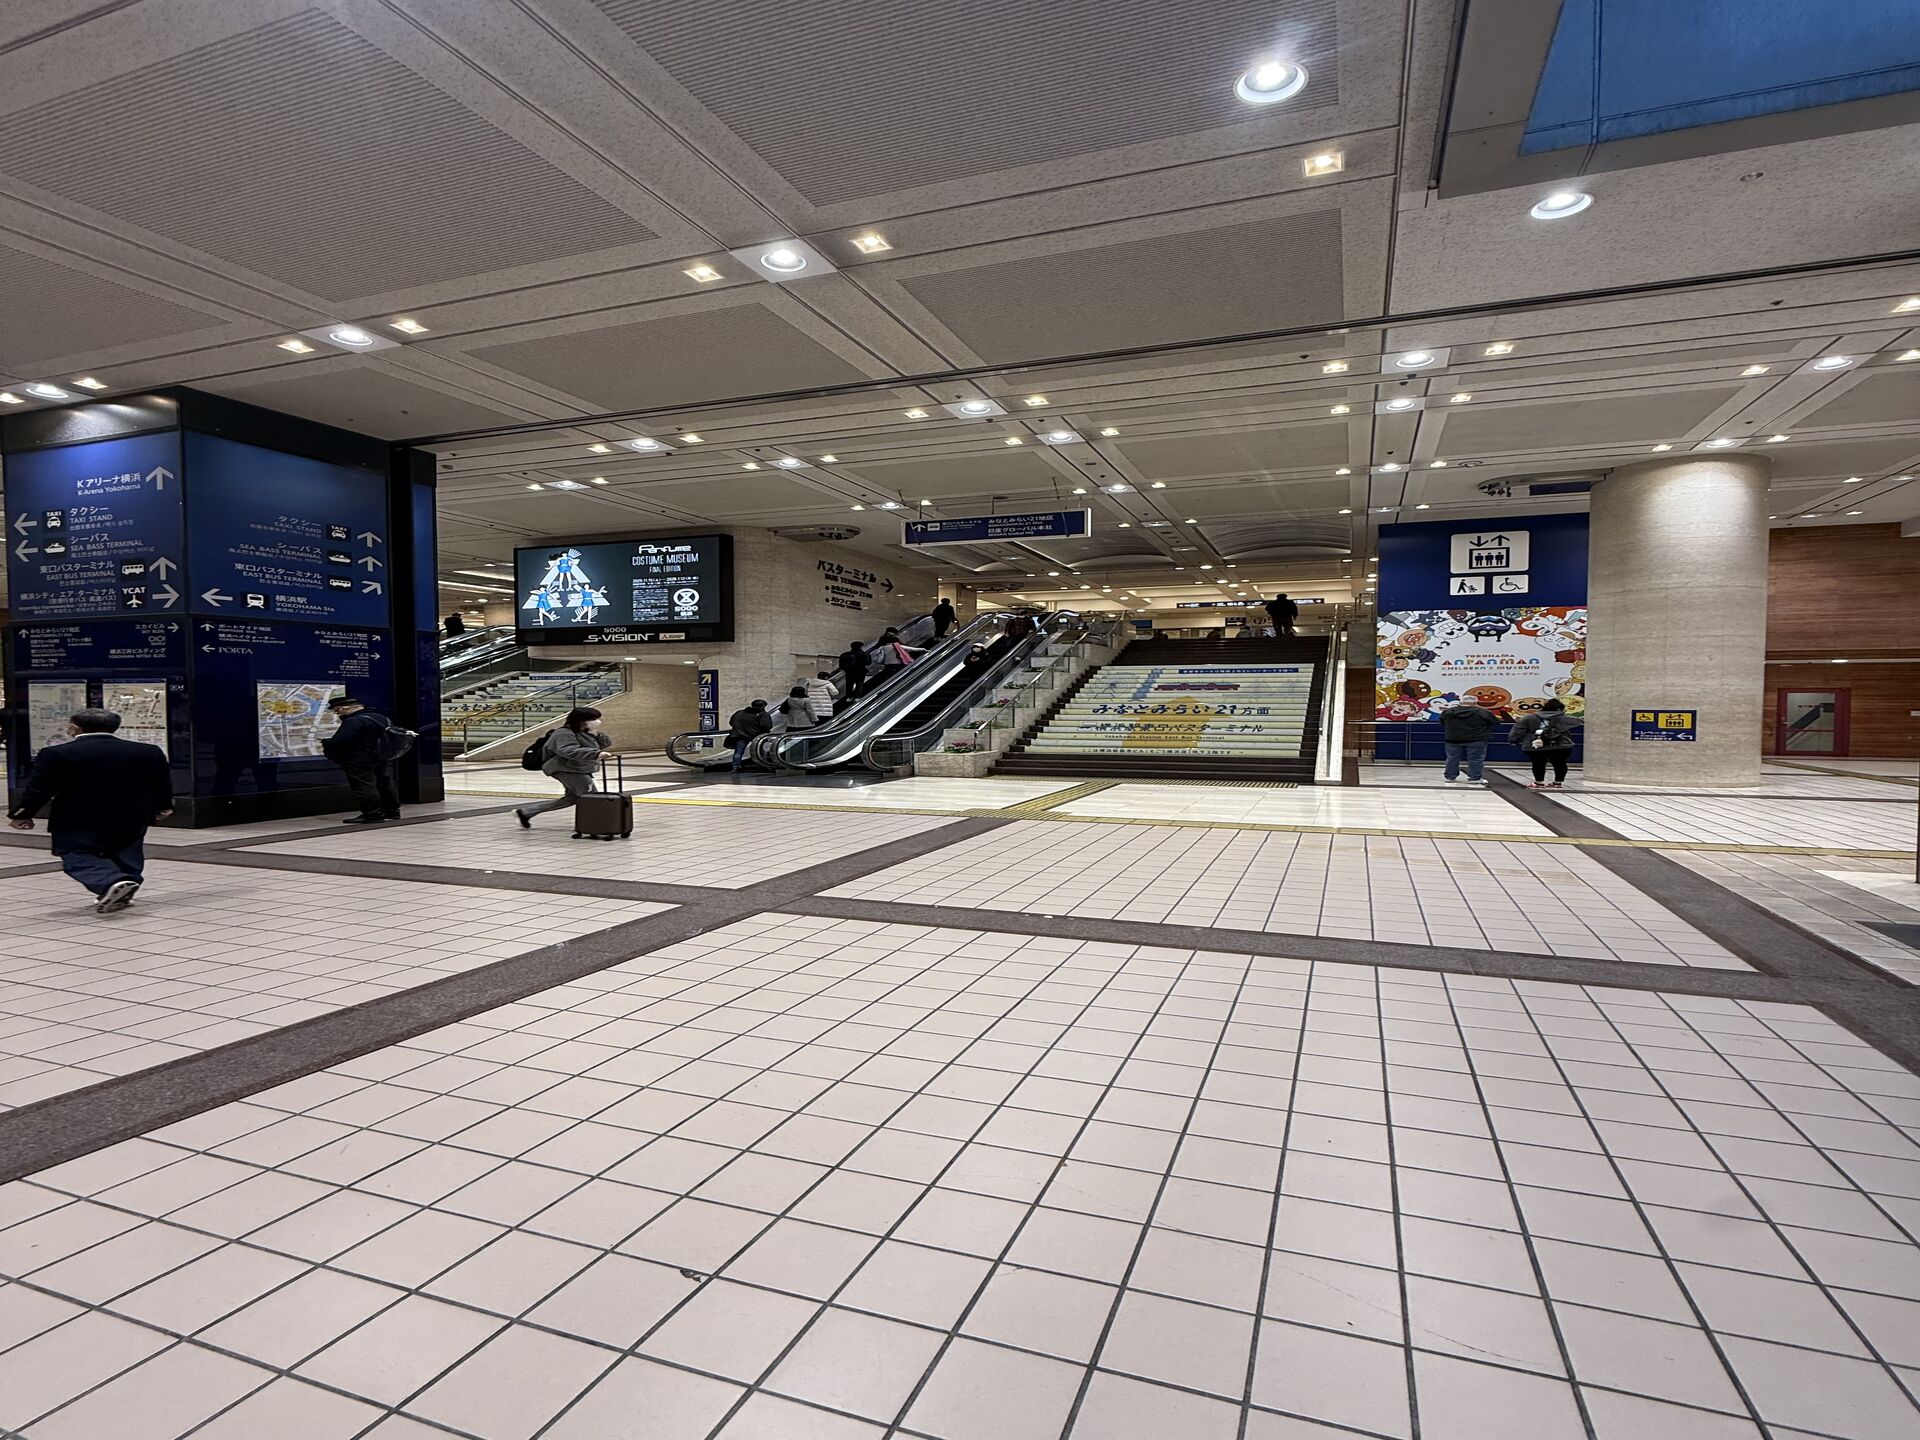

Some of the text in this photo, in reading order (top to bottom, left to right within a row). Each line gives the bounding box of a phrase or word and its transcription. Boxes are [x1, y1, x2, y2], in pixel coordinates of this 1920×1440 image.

[77, 472, 141, 488] Kアリーナ横浜
[78, 483, 141, 496] K-Arena Yokohama
[70, 506, 109, 517] タクシー
[70, 517, 87, 525] TAXI
[89, 514, 113, 523] STAND
[278, 515, 321, 526] タクシー
[988, 514, 1054, 524] みなとみらい21地区
[296, 525, 322, 534] STAND
[988, 525, 1053, 534] 日産グローバル本社
[70, 533, 109, 545] シーバス
[70, 544, 83, 552] SEA
[87, 542, 105, 551] BASS
[106, 540, 143, 549] TERMINAL
[240, 543, 256, 551] SEA
[260, 546, 281, 554] BASS
[283, 549, 322, 560] TERMINAL
[276, 542, 322, 554] シーバス
[632, 553, 699, 565] COSTUME MUSEUM
[40, 561, 115, 574] 東口バスターミナル
[233, 562, 322, 579] 東口バスターミナル
[817, 560, 877, 583] バスターミナル
[46, 570, 116, 581] EAST BUS TERMINAL
[283, 576, 322, 585] TERMINAL
[825, 573, 871, 590] BUS TERMINAL
[275, 594, 308, 604] 横浜駅
[275, 602, 321, 610] YOKOHAMA
[584, 633, 656, 642] S-VISION
[218, 646, 254, 654] PORTA
[1442, 658, 1540, 666] ANPANMAN
[1091, 704, 1271, 715] みなとみらい21方面
[1094, 723, 1264, 733] 横浜駅東口バスターミナル
